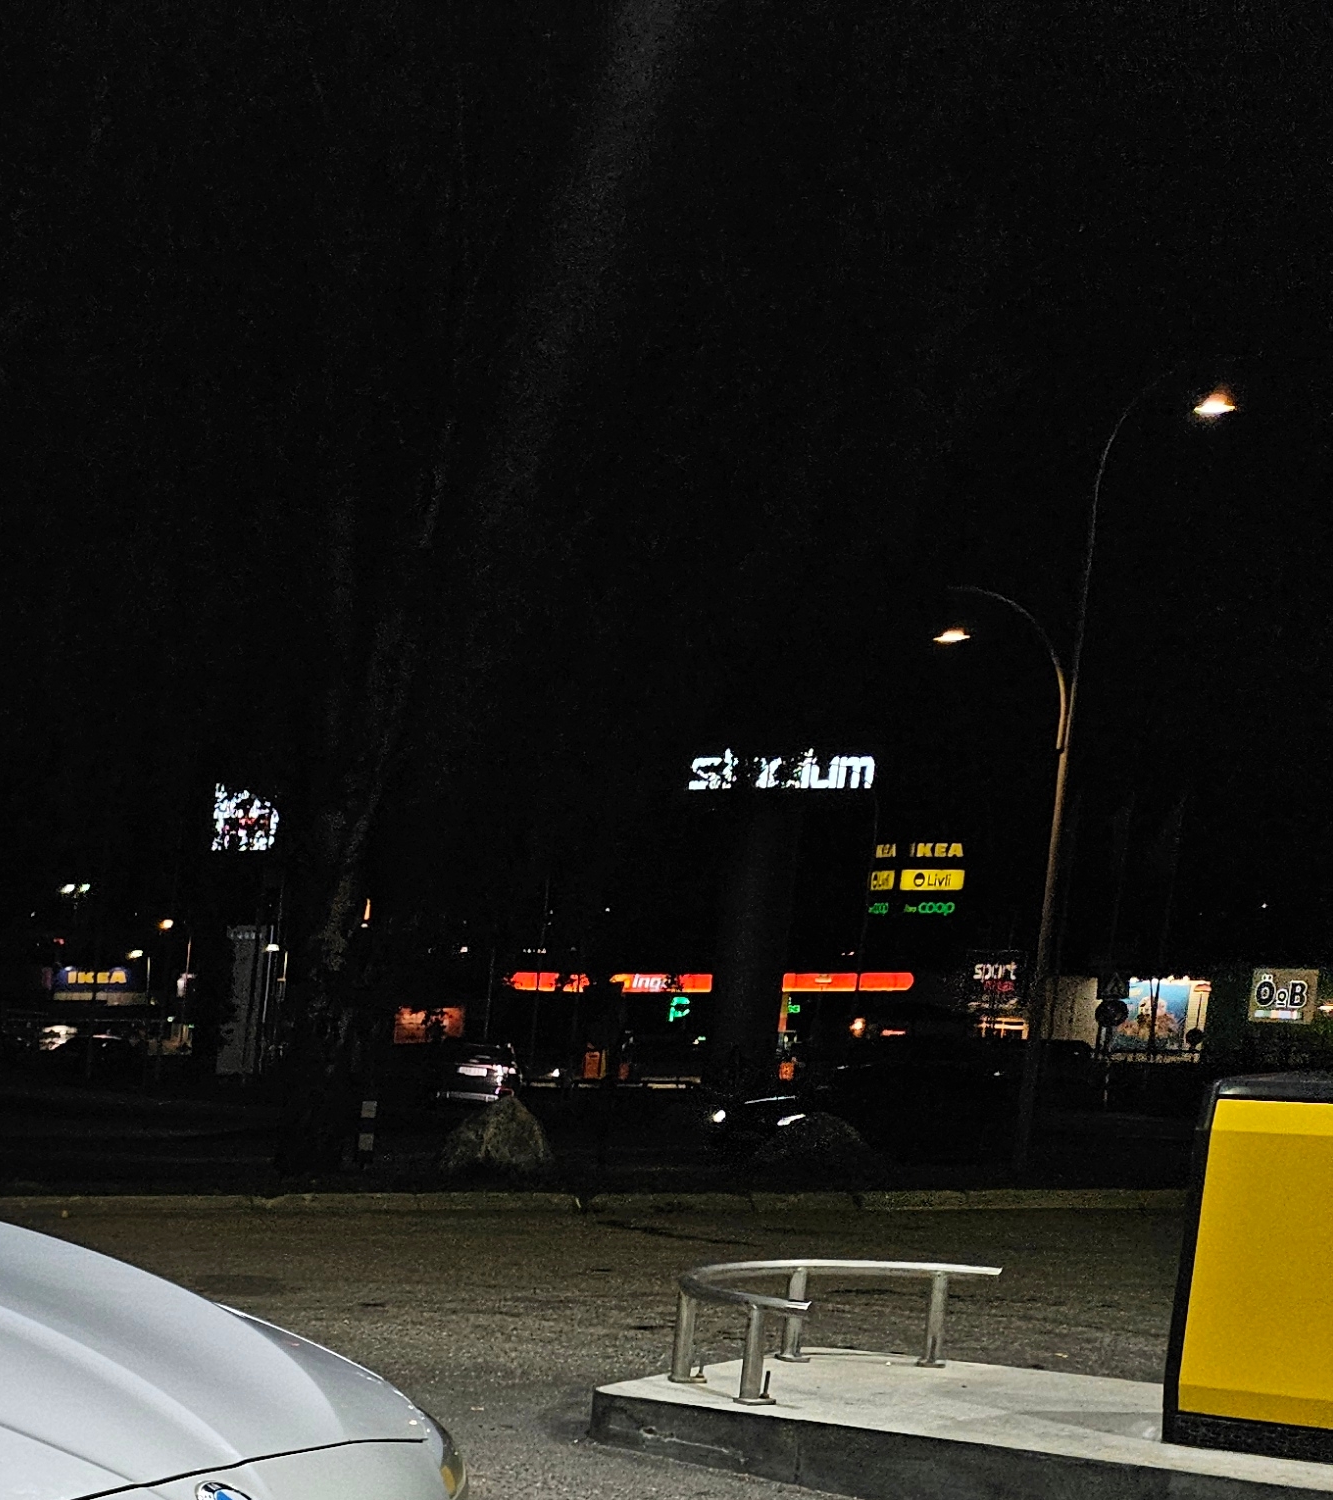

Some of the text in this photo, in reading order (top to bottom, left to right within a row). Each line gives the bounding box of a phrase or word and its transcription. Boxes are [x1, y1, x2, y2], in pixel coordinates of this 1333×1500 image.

[909, 842, 964, 857] IKEA
[927, 873, 951, 887] Livli
[918, 902, 955, 916] coop
[67, 970, 127, 984] IKEA
[1254, 973, 1308, 1008] ÖoB
